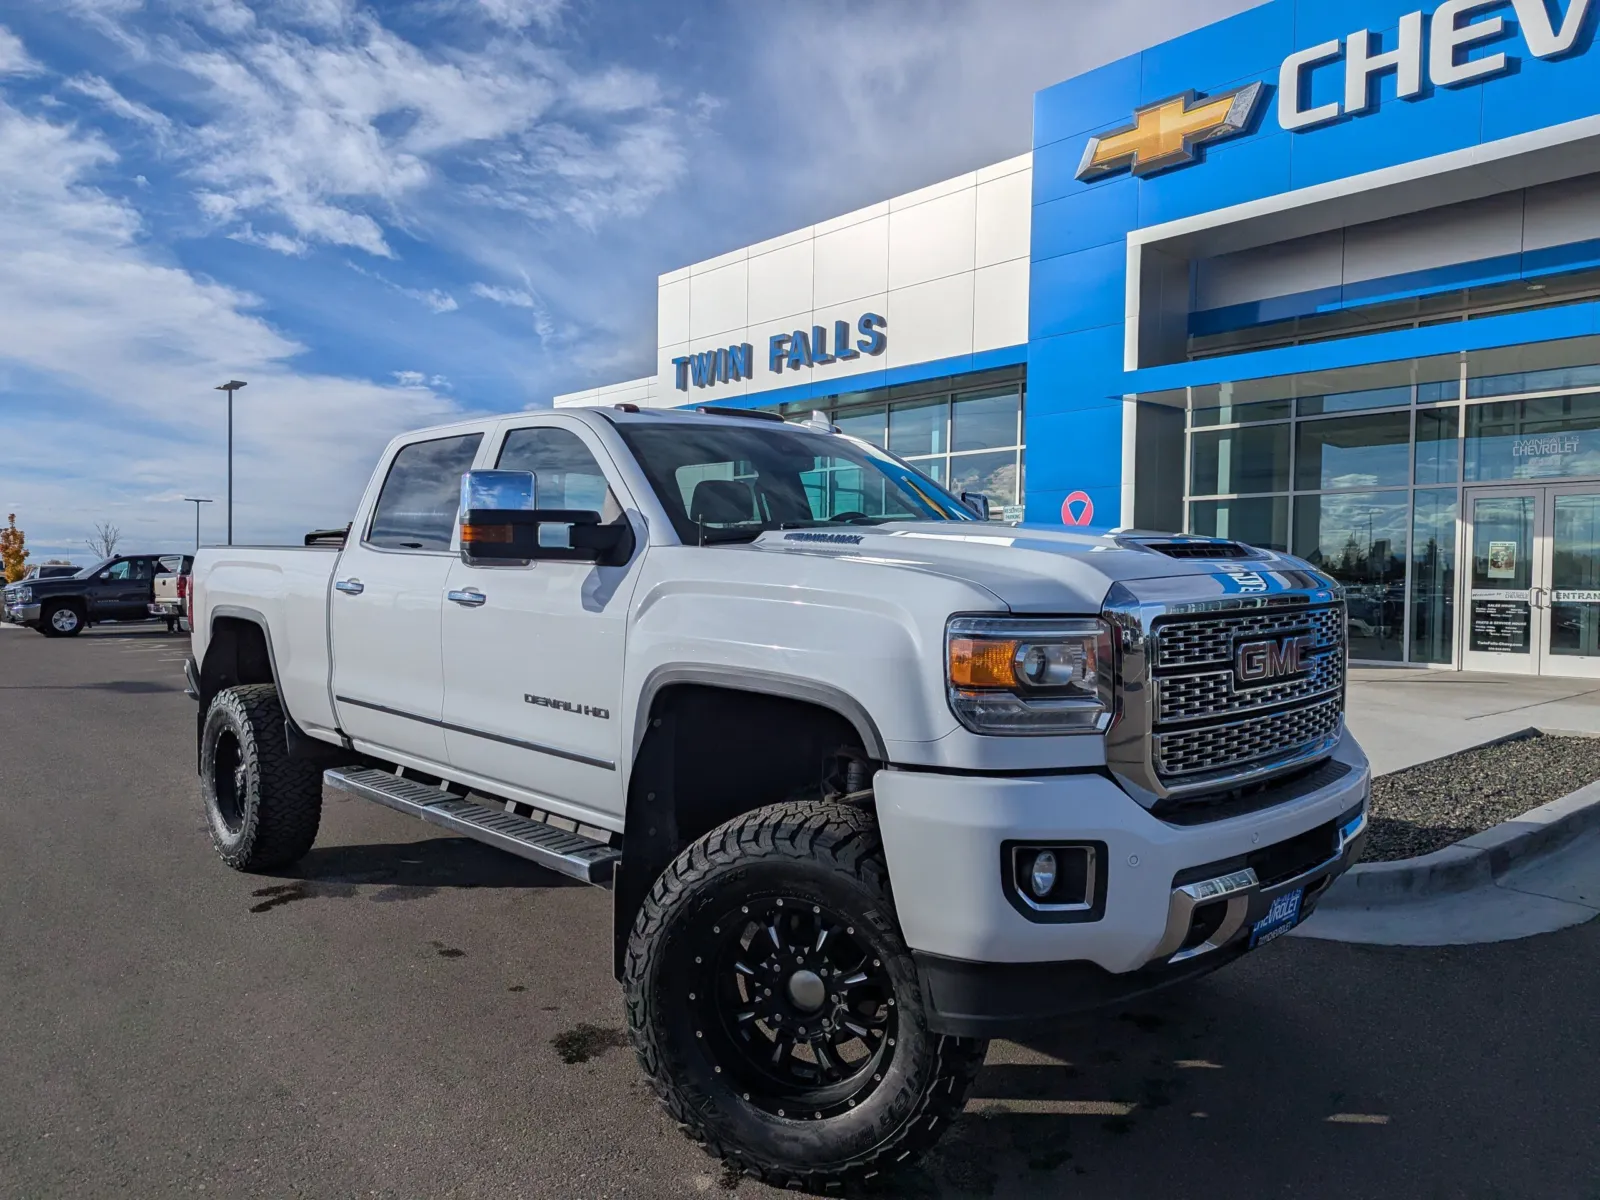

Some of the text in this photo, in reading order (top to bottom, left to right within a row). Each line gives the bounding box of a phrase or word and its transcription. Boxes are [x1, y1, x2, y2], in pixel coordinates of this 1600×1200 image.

[1278, 0, 1590, 131] CHEV
[672, 312, 888, 392] TWIN FALLS
[1512, 442, 1579, 456] CHEVROLET
[1238, 637, 1314, 681] GMC
[524, 693, 610, 719] DENALI HD
